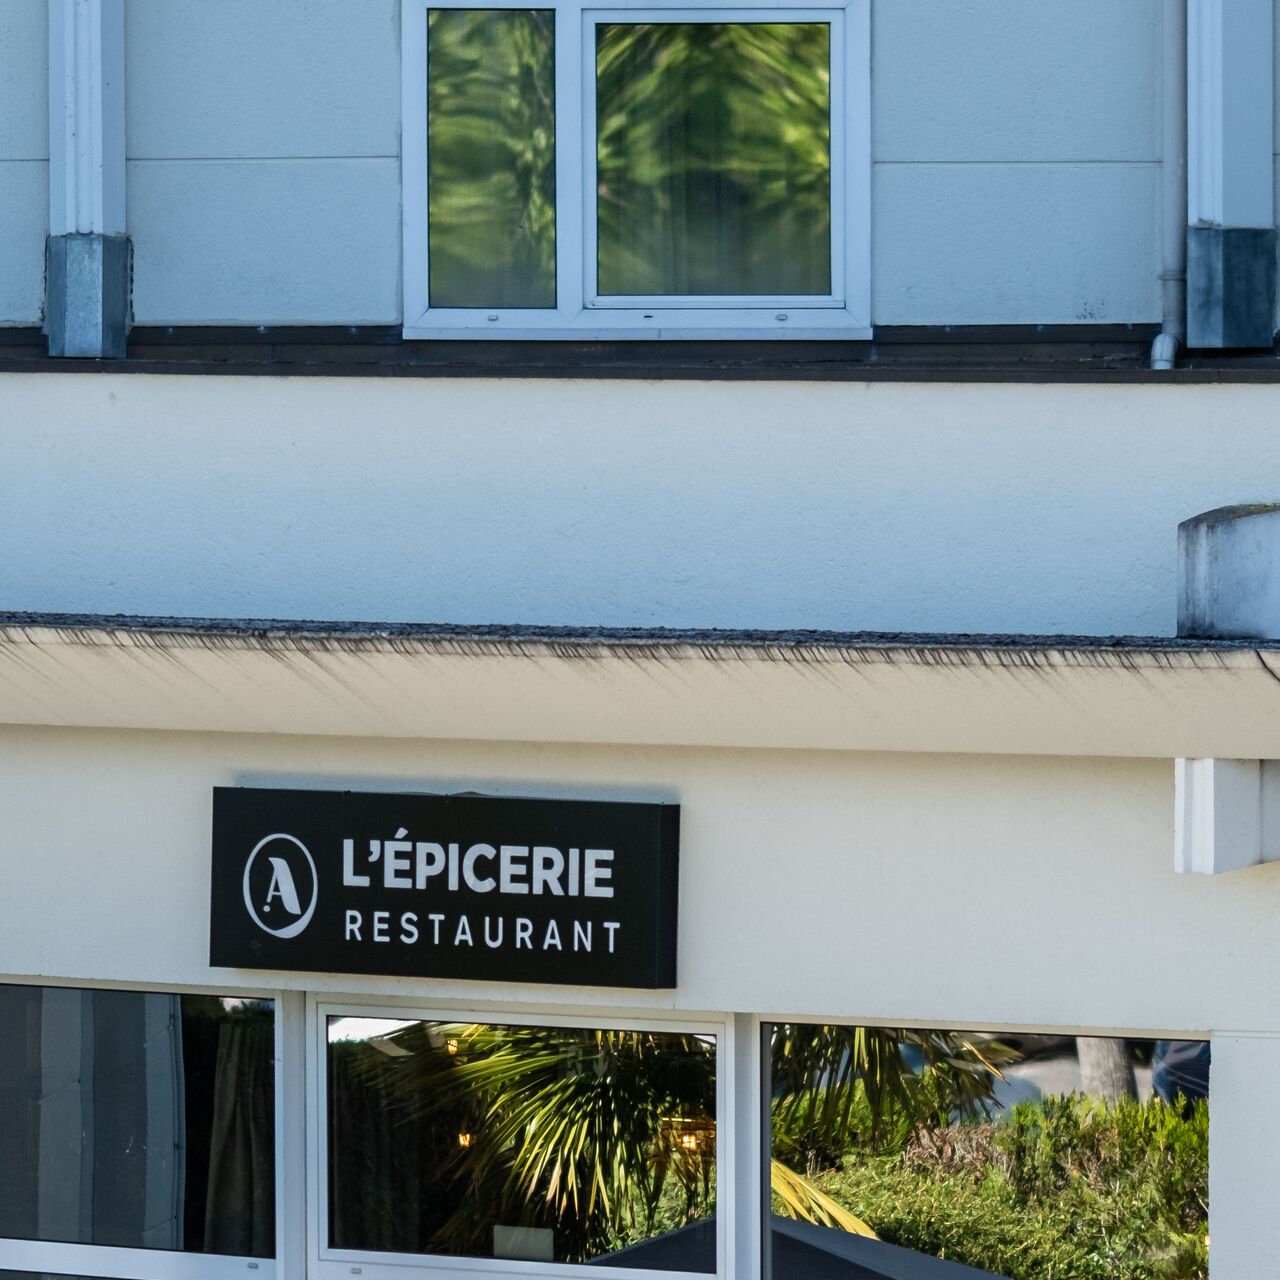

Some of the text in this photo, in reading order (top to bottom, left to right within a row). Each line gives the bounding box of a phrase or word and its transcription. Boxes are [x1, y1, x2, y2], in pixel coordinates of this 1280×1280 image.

[263, 857, 302, 916] A
[342, 827, 615, 898] L’ÉPICERIE
[344, 909, 621, 954] RESTAURANT
